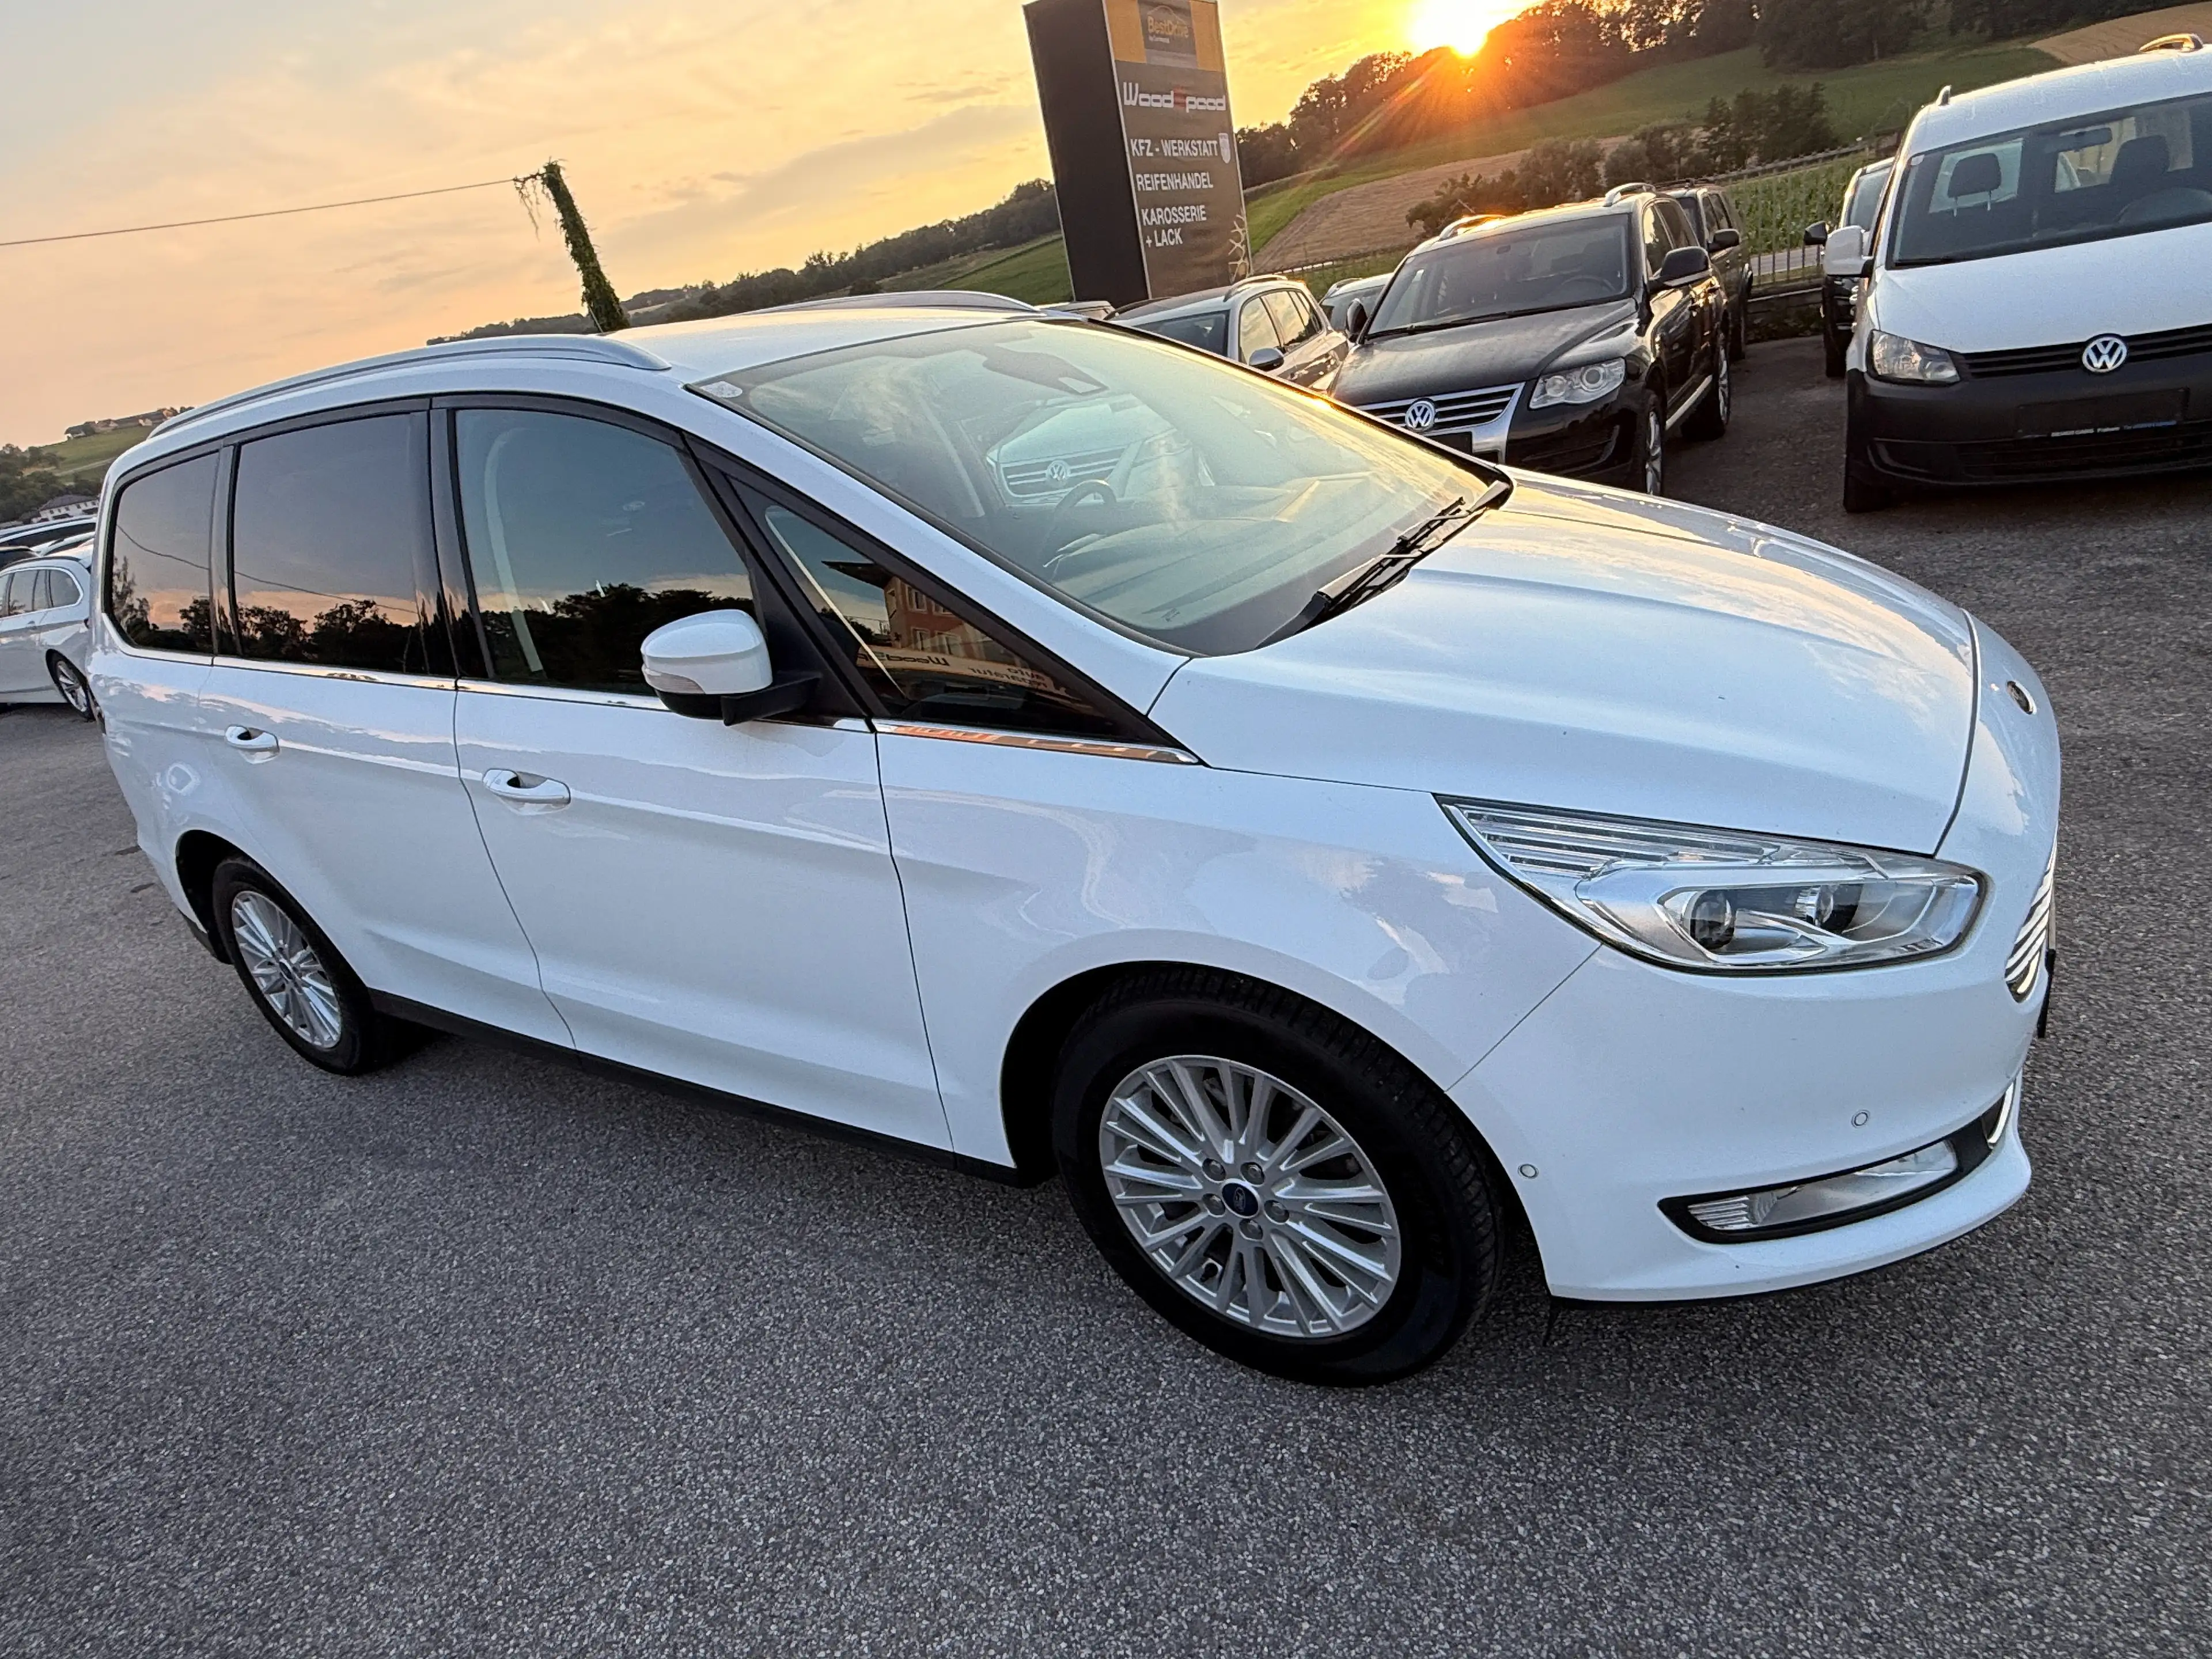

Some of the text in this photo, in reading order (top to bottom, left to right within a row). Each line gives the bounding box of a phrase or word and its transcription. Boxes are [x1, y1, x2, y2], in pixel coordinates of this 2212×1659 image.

[1130, 138, 1153, 157] KFZ
[1161, 139, 1218, 157] WERKSTATT
[1136, 172, 1213, 192] REIFENHANDEL
[1141, 204, 1207, 226] KAROSSERIE
[1154, 228, 1183, 248] LACK
[2082, 337, 2127, 373] VW
[1405, 401, 1435, 431] VW
